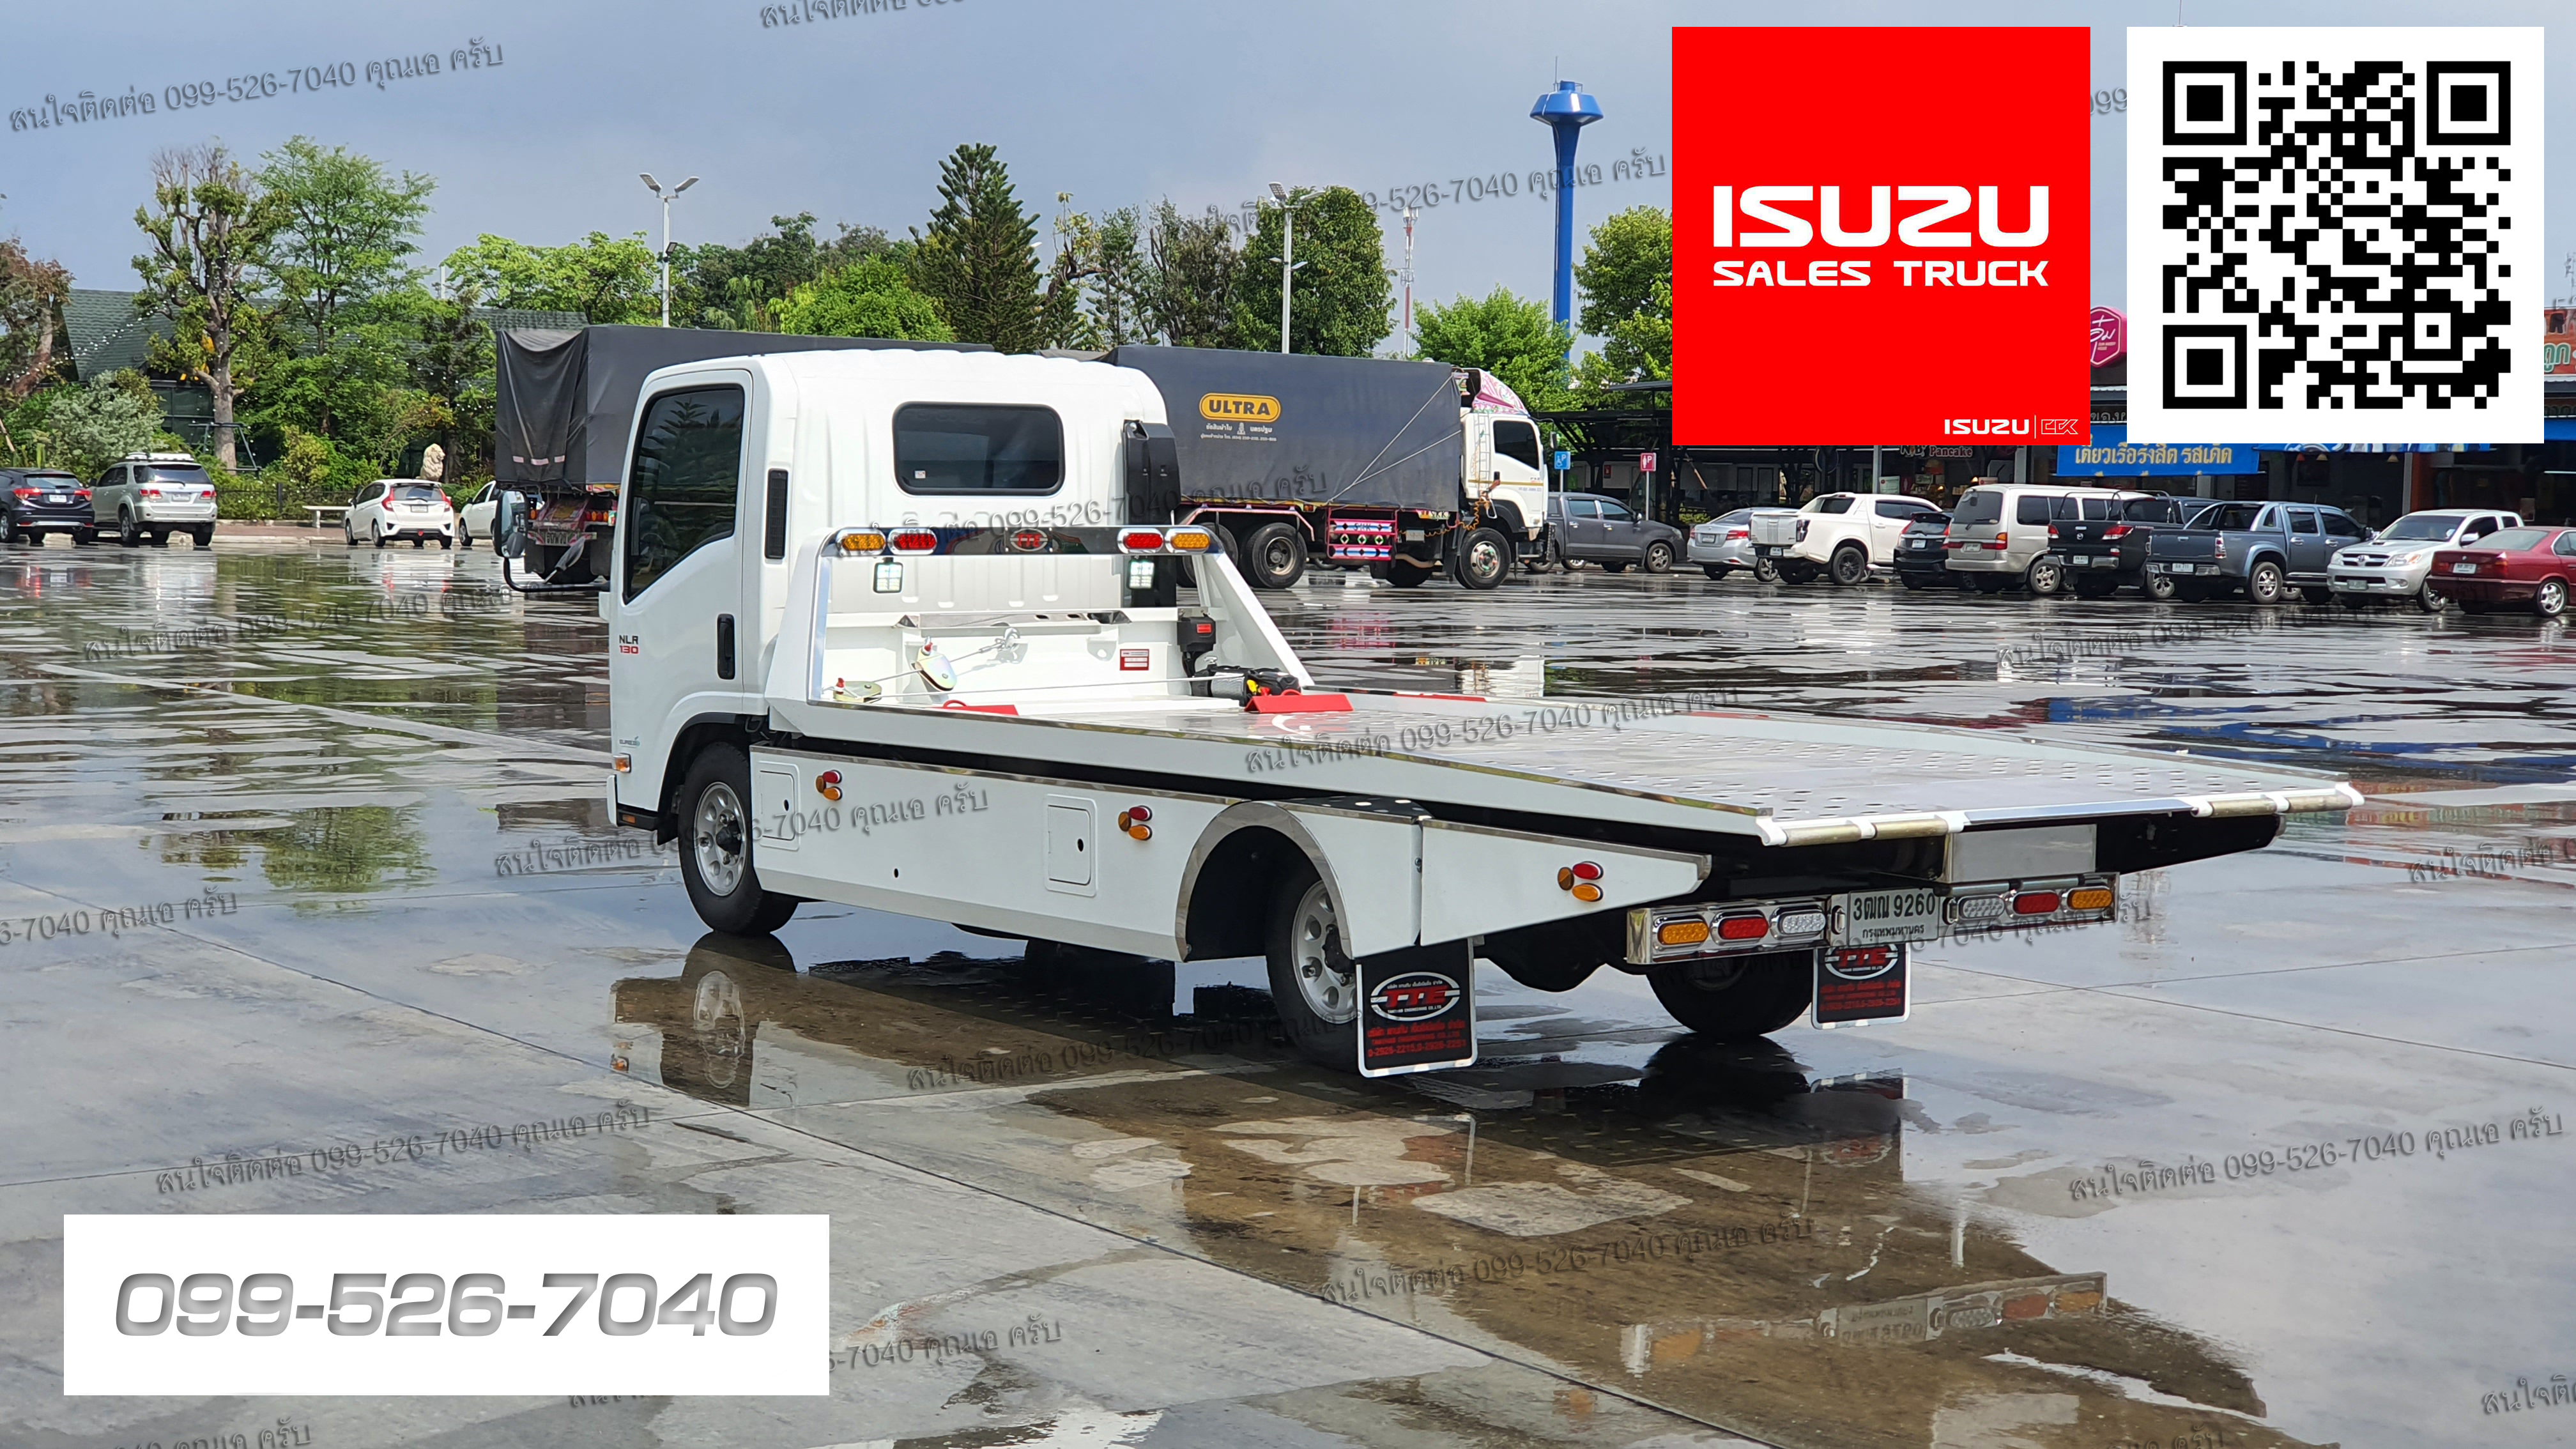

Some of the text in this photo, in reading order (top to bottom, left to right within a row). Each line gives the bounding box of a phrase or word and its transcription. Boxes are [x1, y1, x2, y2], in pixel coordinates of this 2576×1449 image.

[1209, 400, 1271, 415] ULTRA
[1929, 446, 1973, 457] Pancake
[619, 634, 639, 645] NLR
[619, 645, 639, 654] 130
[1894, 893, 1935, 917] 9260
[1862, 924, 1924, 942] กรุงเทพมหานคร
[1385, 985, 1448, 1008] TTE
